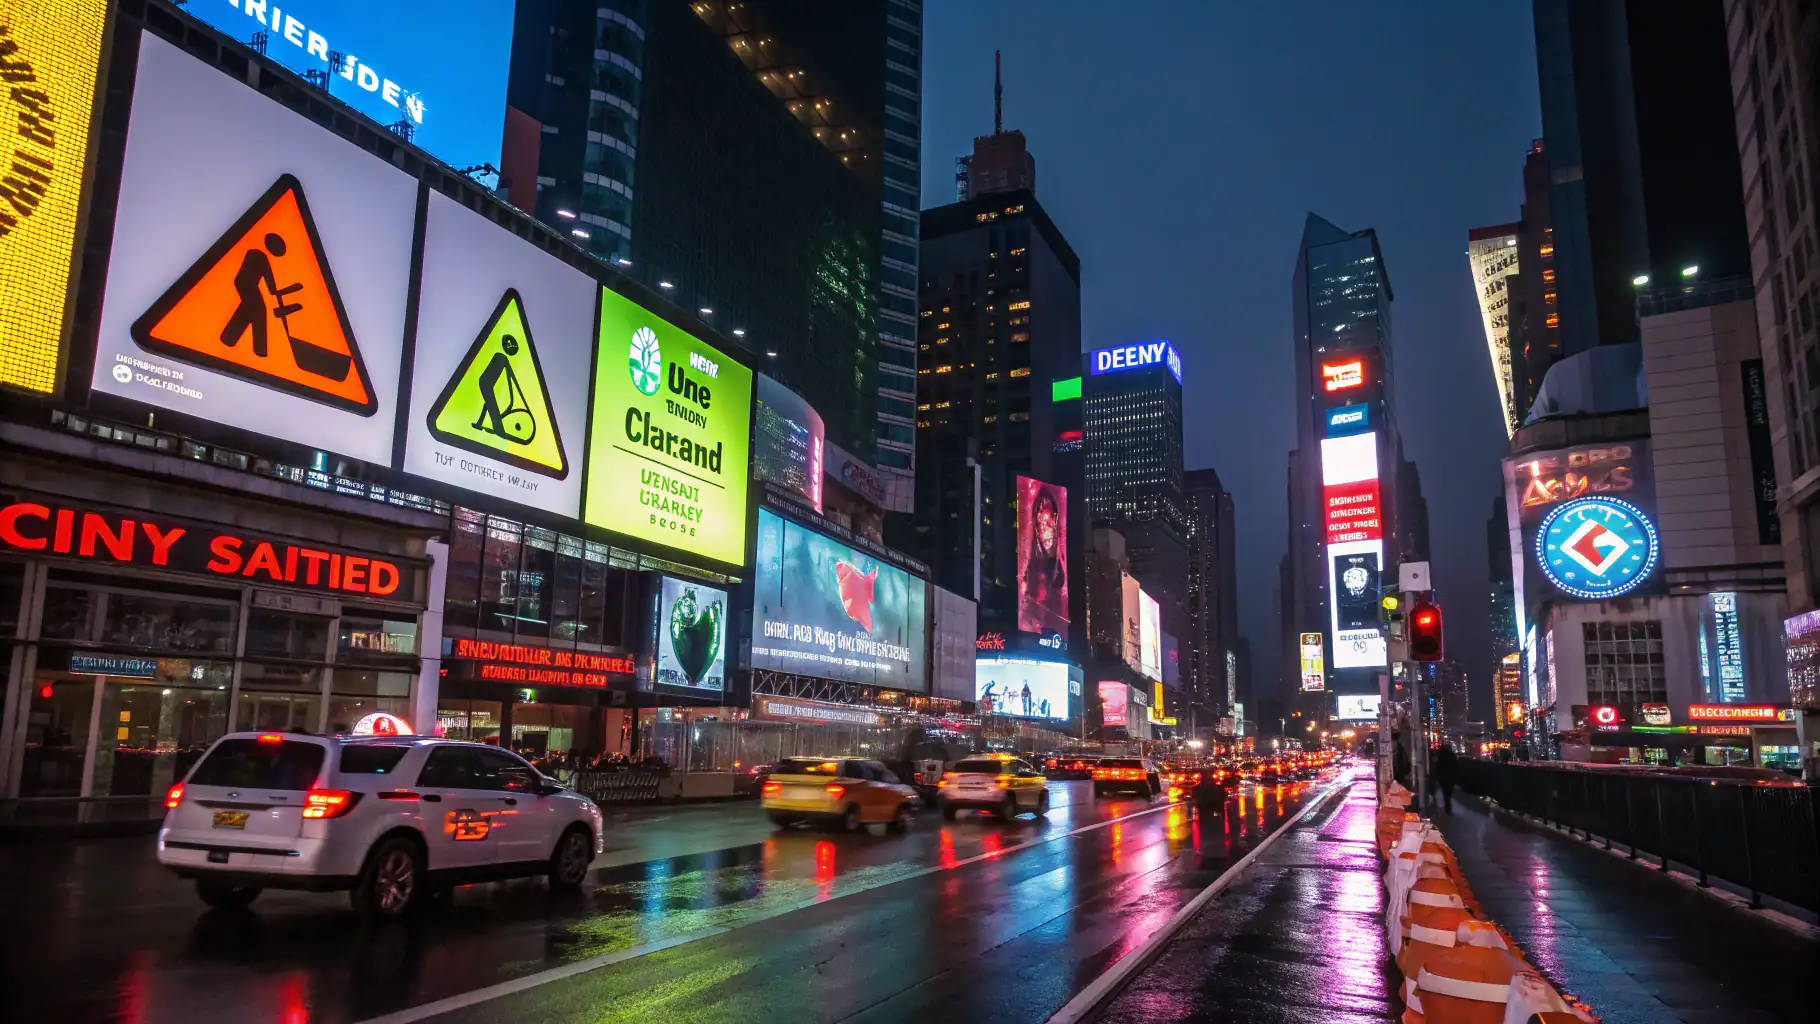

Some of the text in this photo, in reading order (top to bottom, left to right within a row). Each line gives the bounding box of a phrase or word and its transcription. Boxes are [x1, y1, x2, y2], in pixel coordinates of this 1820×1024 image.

[1098, 342, 1166, 371] DEENY
[668, 362, 711, 410] Une
[0, 503, 400, 595] CINY SAITIED
